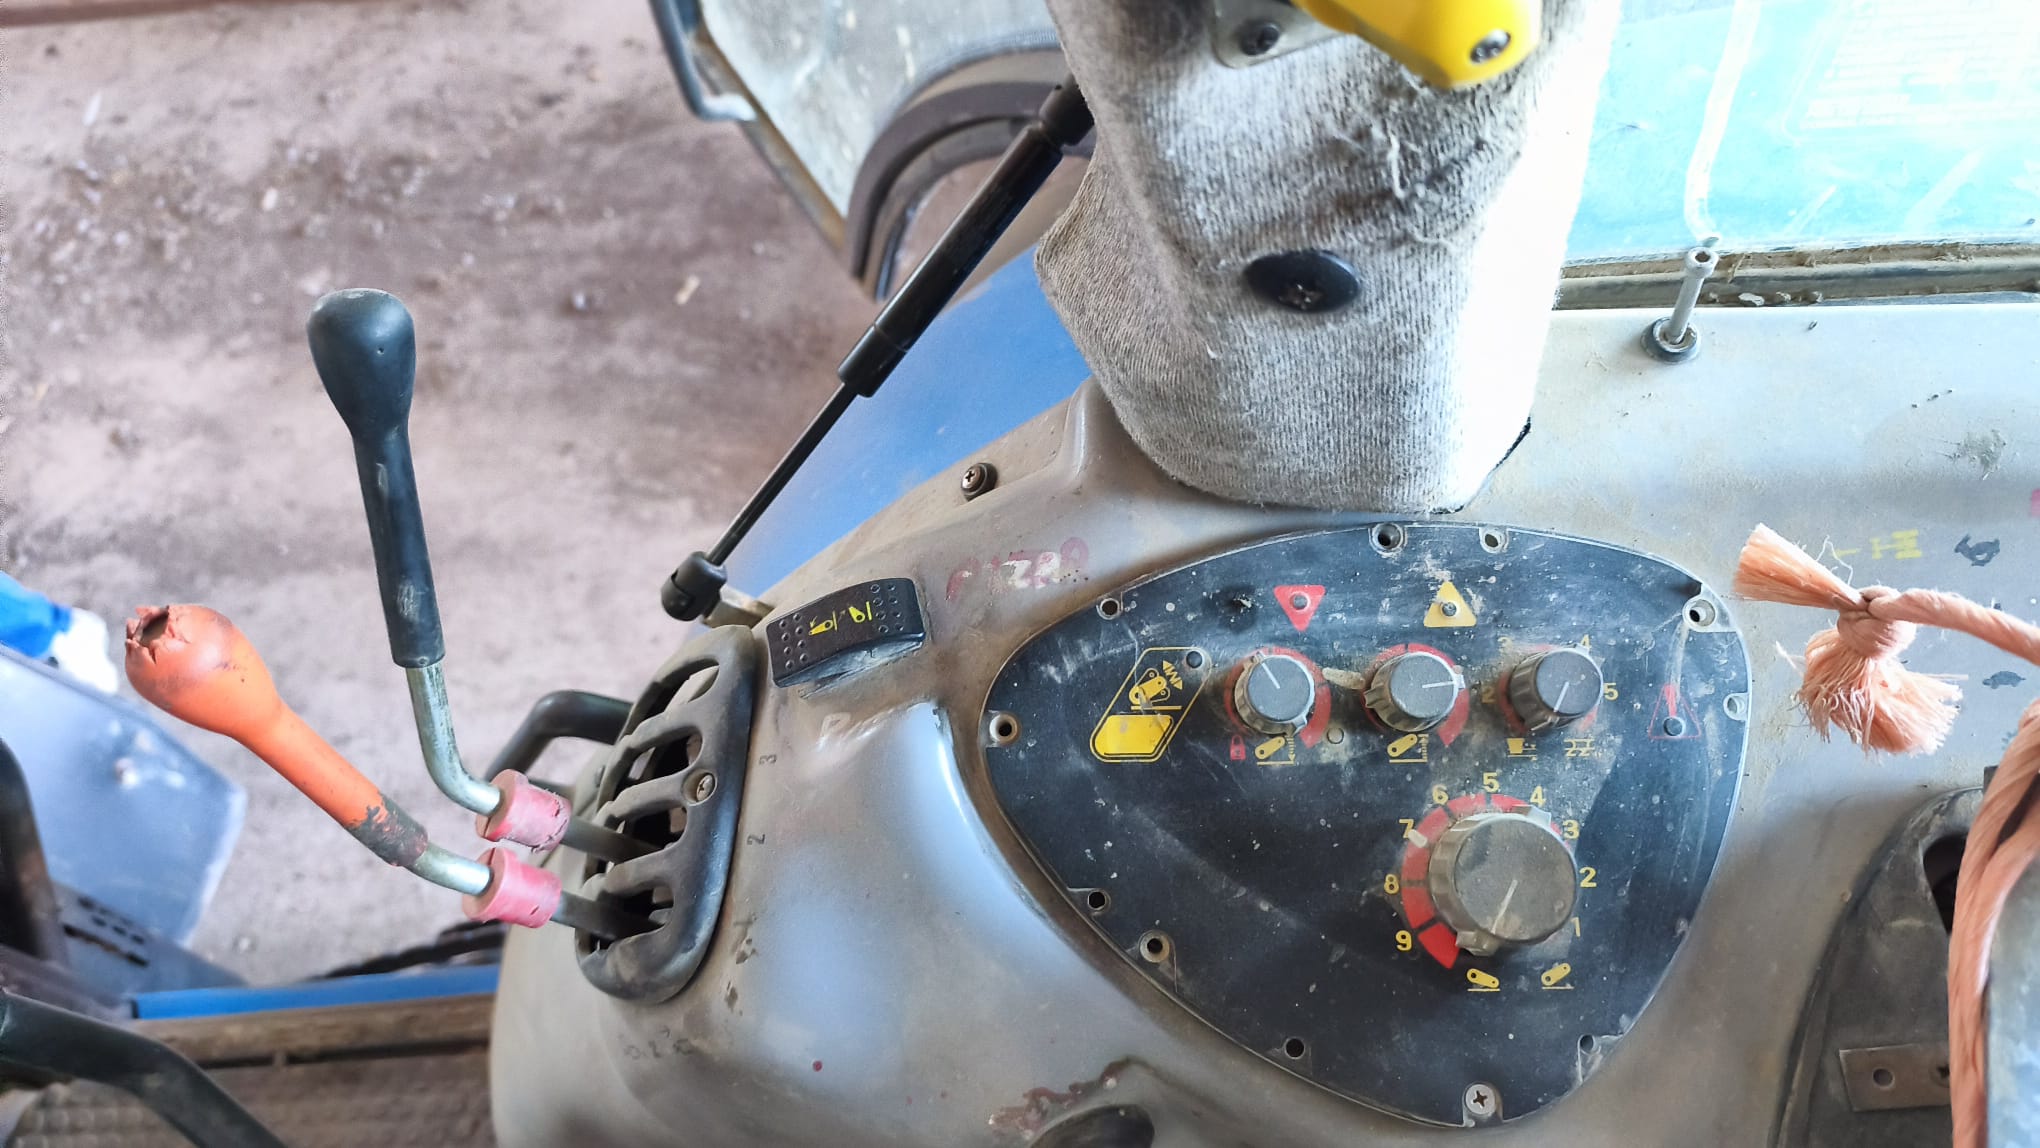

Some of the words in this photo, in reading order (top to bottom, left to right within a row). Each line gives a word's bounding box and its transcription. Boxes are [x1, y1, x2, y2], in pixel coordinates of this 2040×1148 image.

[1482, 687, 1496, 703] 2
[1603, 682, 1619, 700] 5
[759, 754, 777, 765] 3
[1483, 772, 1500, 792] 5
[1432, 785, 1449, 805] 6
[1530, 785, 1546, 805] 4
[1399, 819, 1414, 838] 7
[1563, 820, 1579, 839] 3
[746, 833, 765, 845] 2
[1384, 874, 1400, 894] 8
[1579, 867, 1597, 888] 2
[1570, 917, 1581, 938] 1
[1395, 930, 1412, 951] 9
